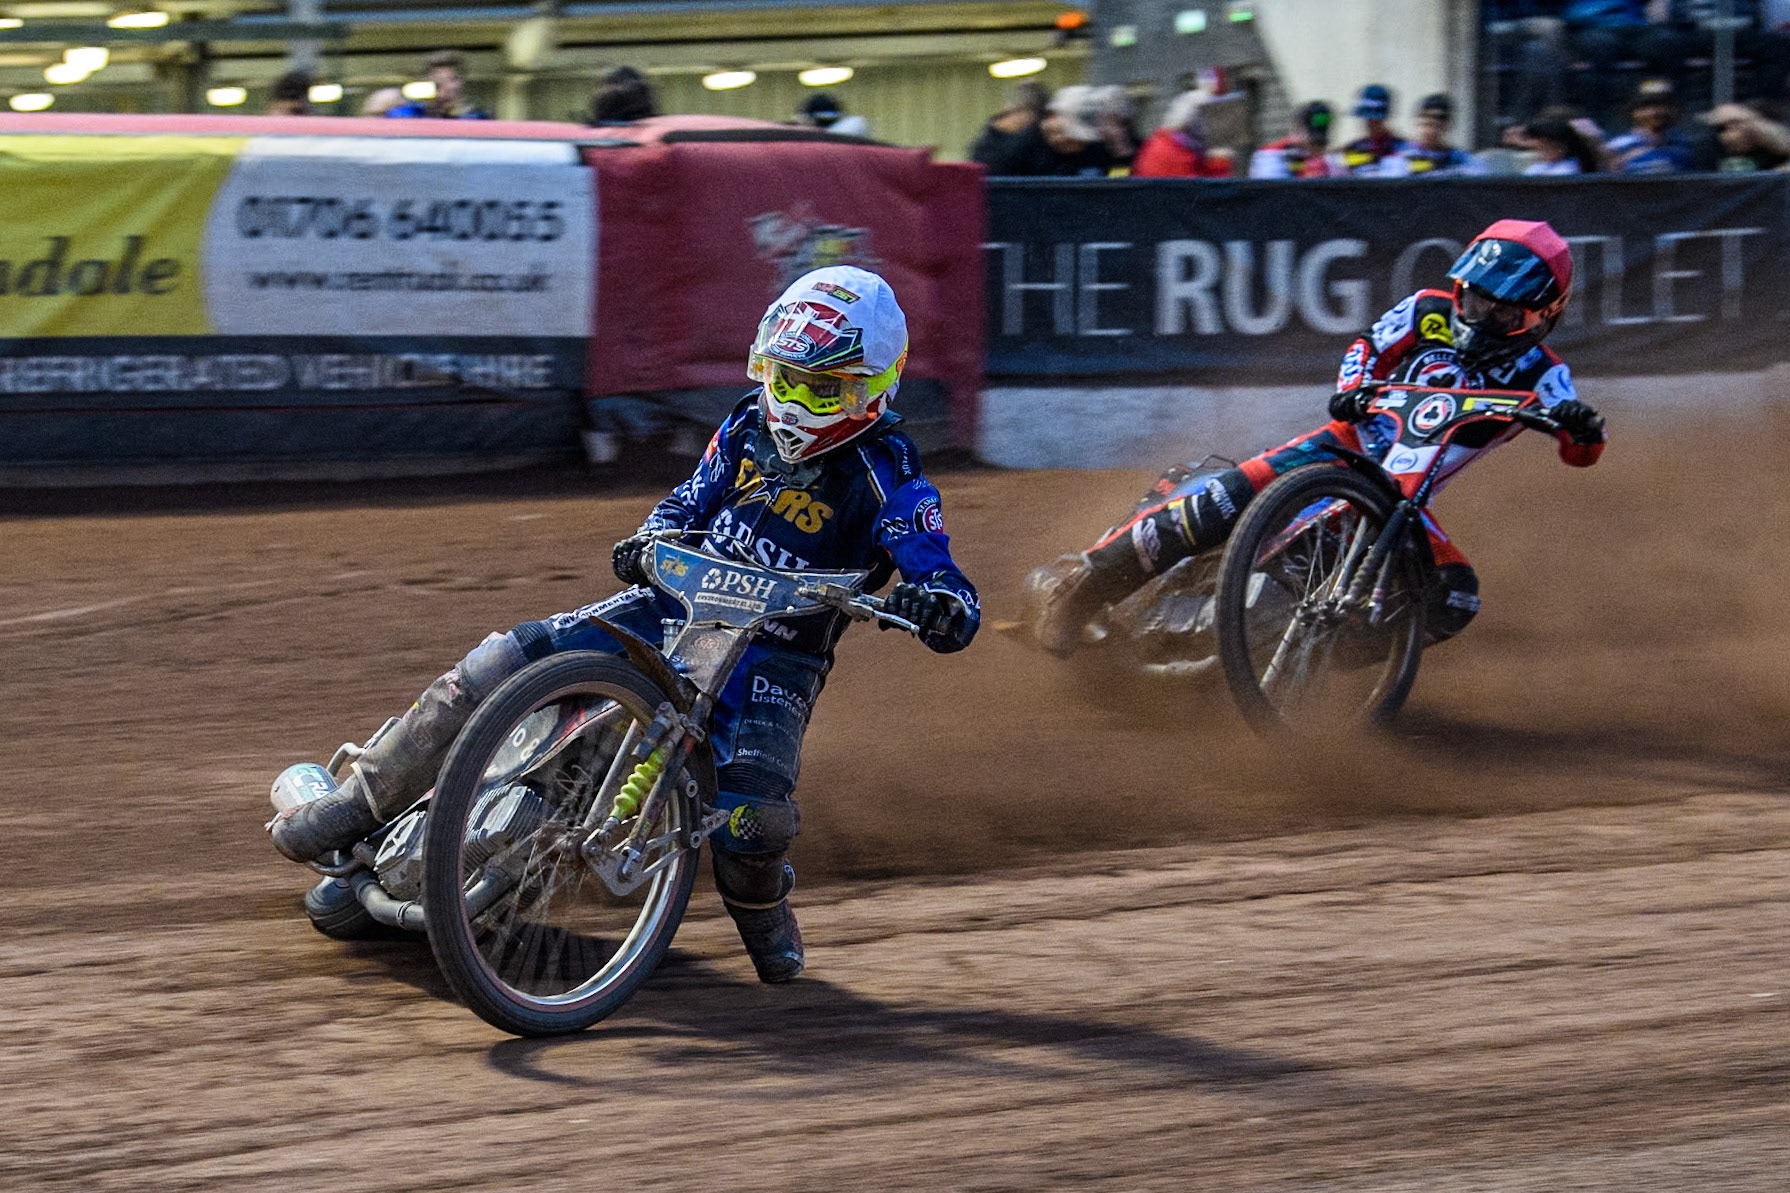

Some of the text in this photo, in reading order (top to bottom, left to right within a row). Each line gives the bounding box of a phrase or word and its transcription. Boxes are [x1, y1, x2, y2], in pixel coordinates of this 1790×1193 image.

[237, 196, 566, 243] 01706 640055
[978, 240, 1133, 336] HE
[1153, 238, 1372, 336] RUG
[775, 339, 807, 353] STS
[928, 508, 943, 531] STS
[720, 569, 778, 600] PSH
